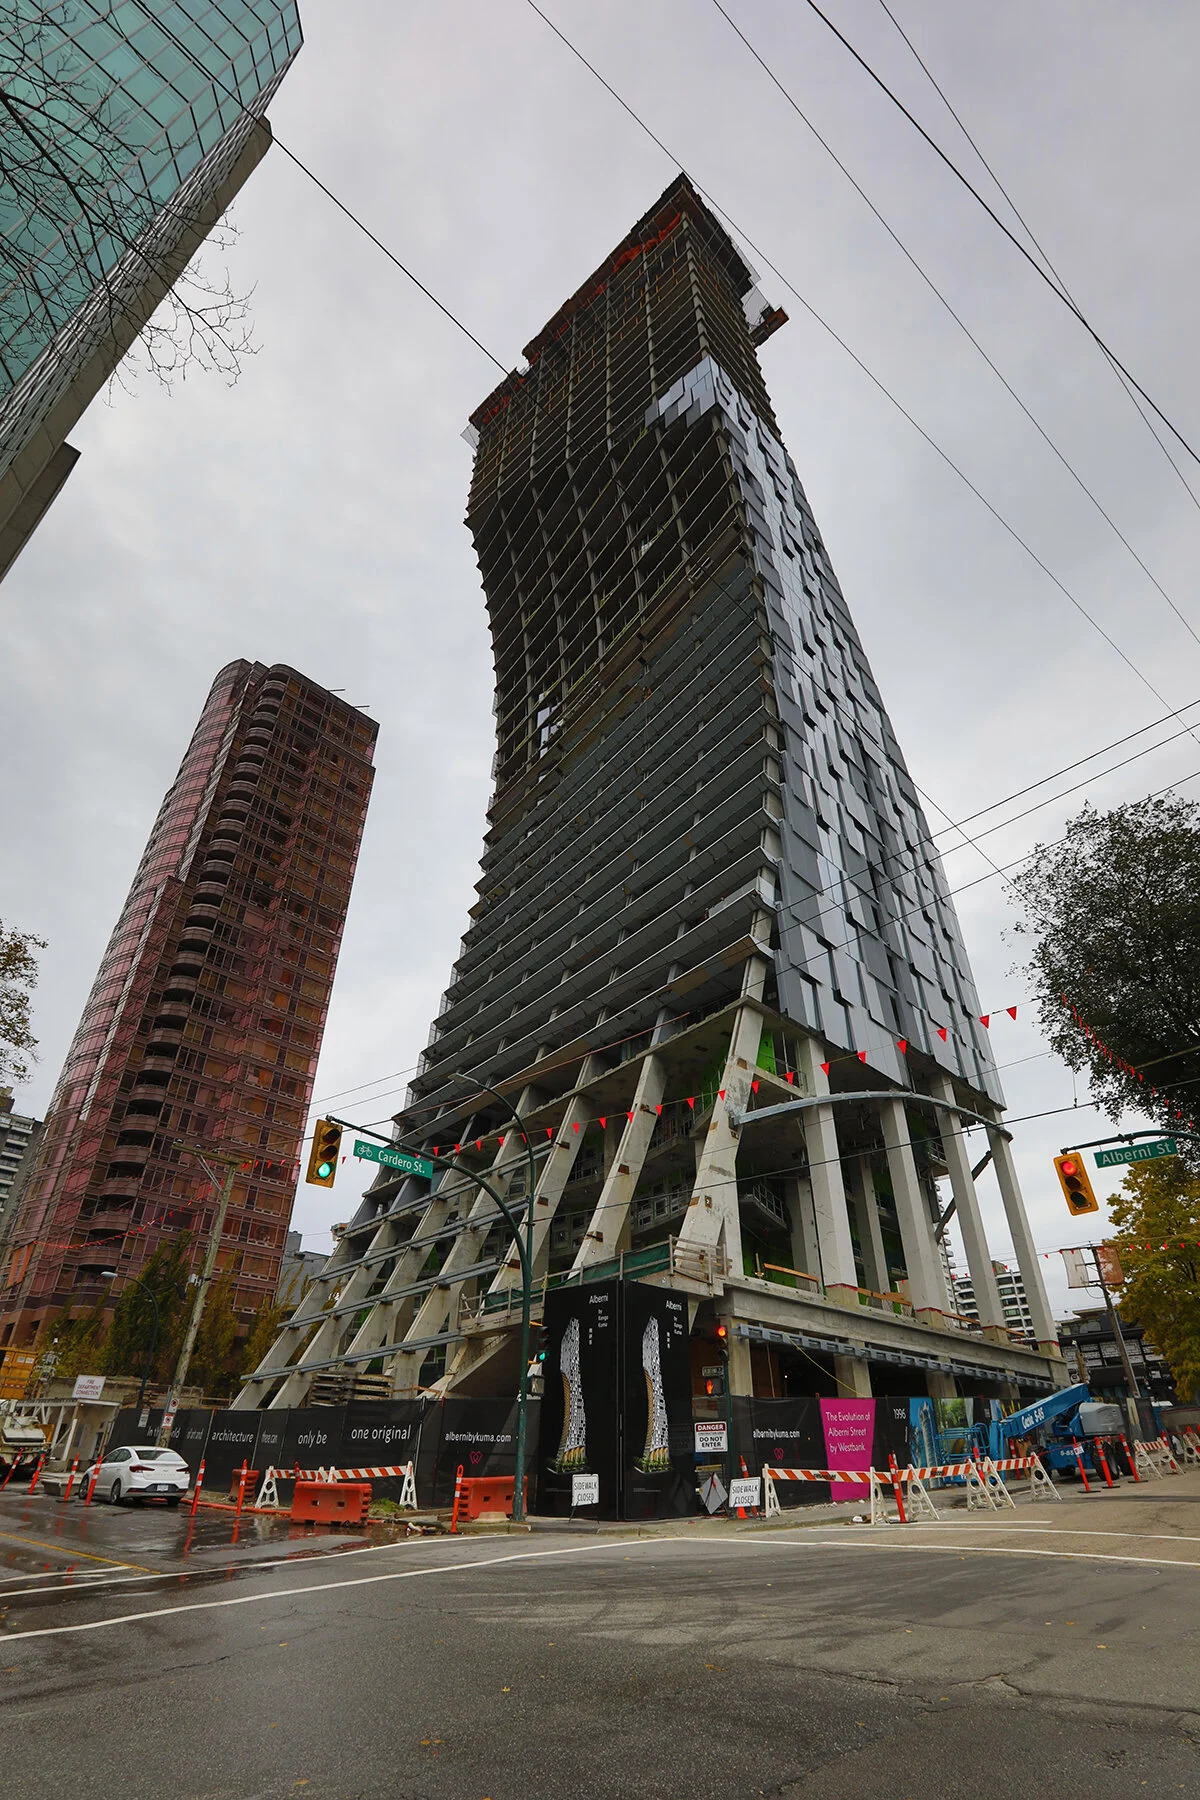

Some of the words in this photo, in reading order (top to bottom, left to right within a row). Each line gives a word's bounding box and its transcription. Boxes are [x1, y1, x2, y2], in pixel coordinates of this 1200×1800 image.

[1102, 1145, 1152, 1165] Alberni
[1156, 1142, 1172, 1155] St
[378, 1150, 412, 1170] Cardero
[413, 1160, 426, 1174] St.
[589, 1293, 609, 1304] Alberni
[665, 1300, 682, 1311] Alberni
[825, 1411, 837, 1421] The
[838, 1411, 865, 1421] Evolution
[865, 1411, 871, 1420] of
[893, 1408, 906, 1419] 1996
[211, 1429, 254, 1443] architecture
[351, 1428, 369, 1440] one
[371, 1424, 412, 1444] original
[445, 1431, 512, 1443] albernibykuma.com
[753, 1428, 800, 1440] albernibykuma.com
[828, 1427, 849, 1437] Alberni
[850, 1427, 867, 1437] Street
[298, 1430, 315, 1448] only
[316, 1430, 328, 1445] be
[830, 1444, 837, 1455] by
[838, 1442, 866, 1452] Westbank
[574, 1481, 598, 1491] SIDEWALK
[732, 1485, 758, 1494] SIDEWALK
[577, 1493, 595, 1502] CLOSED
[734, 1496, 755, 1504] CLOSED
